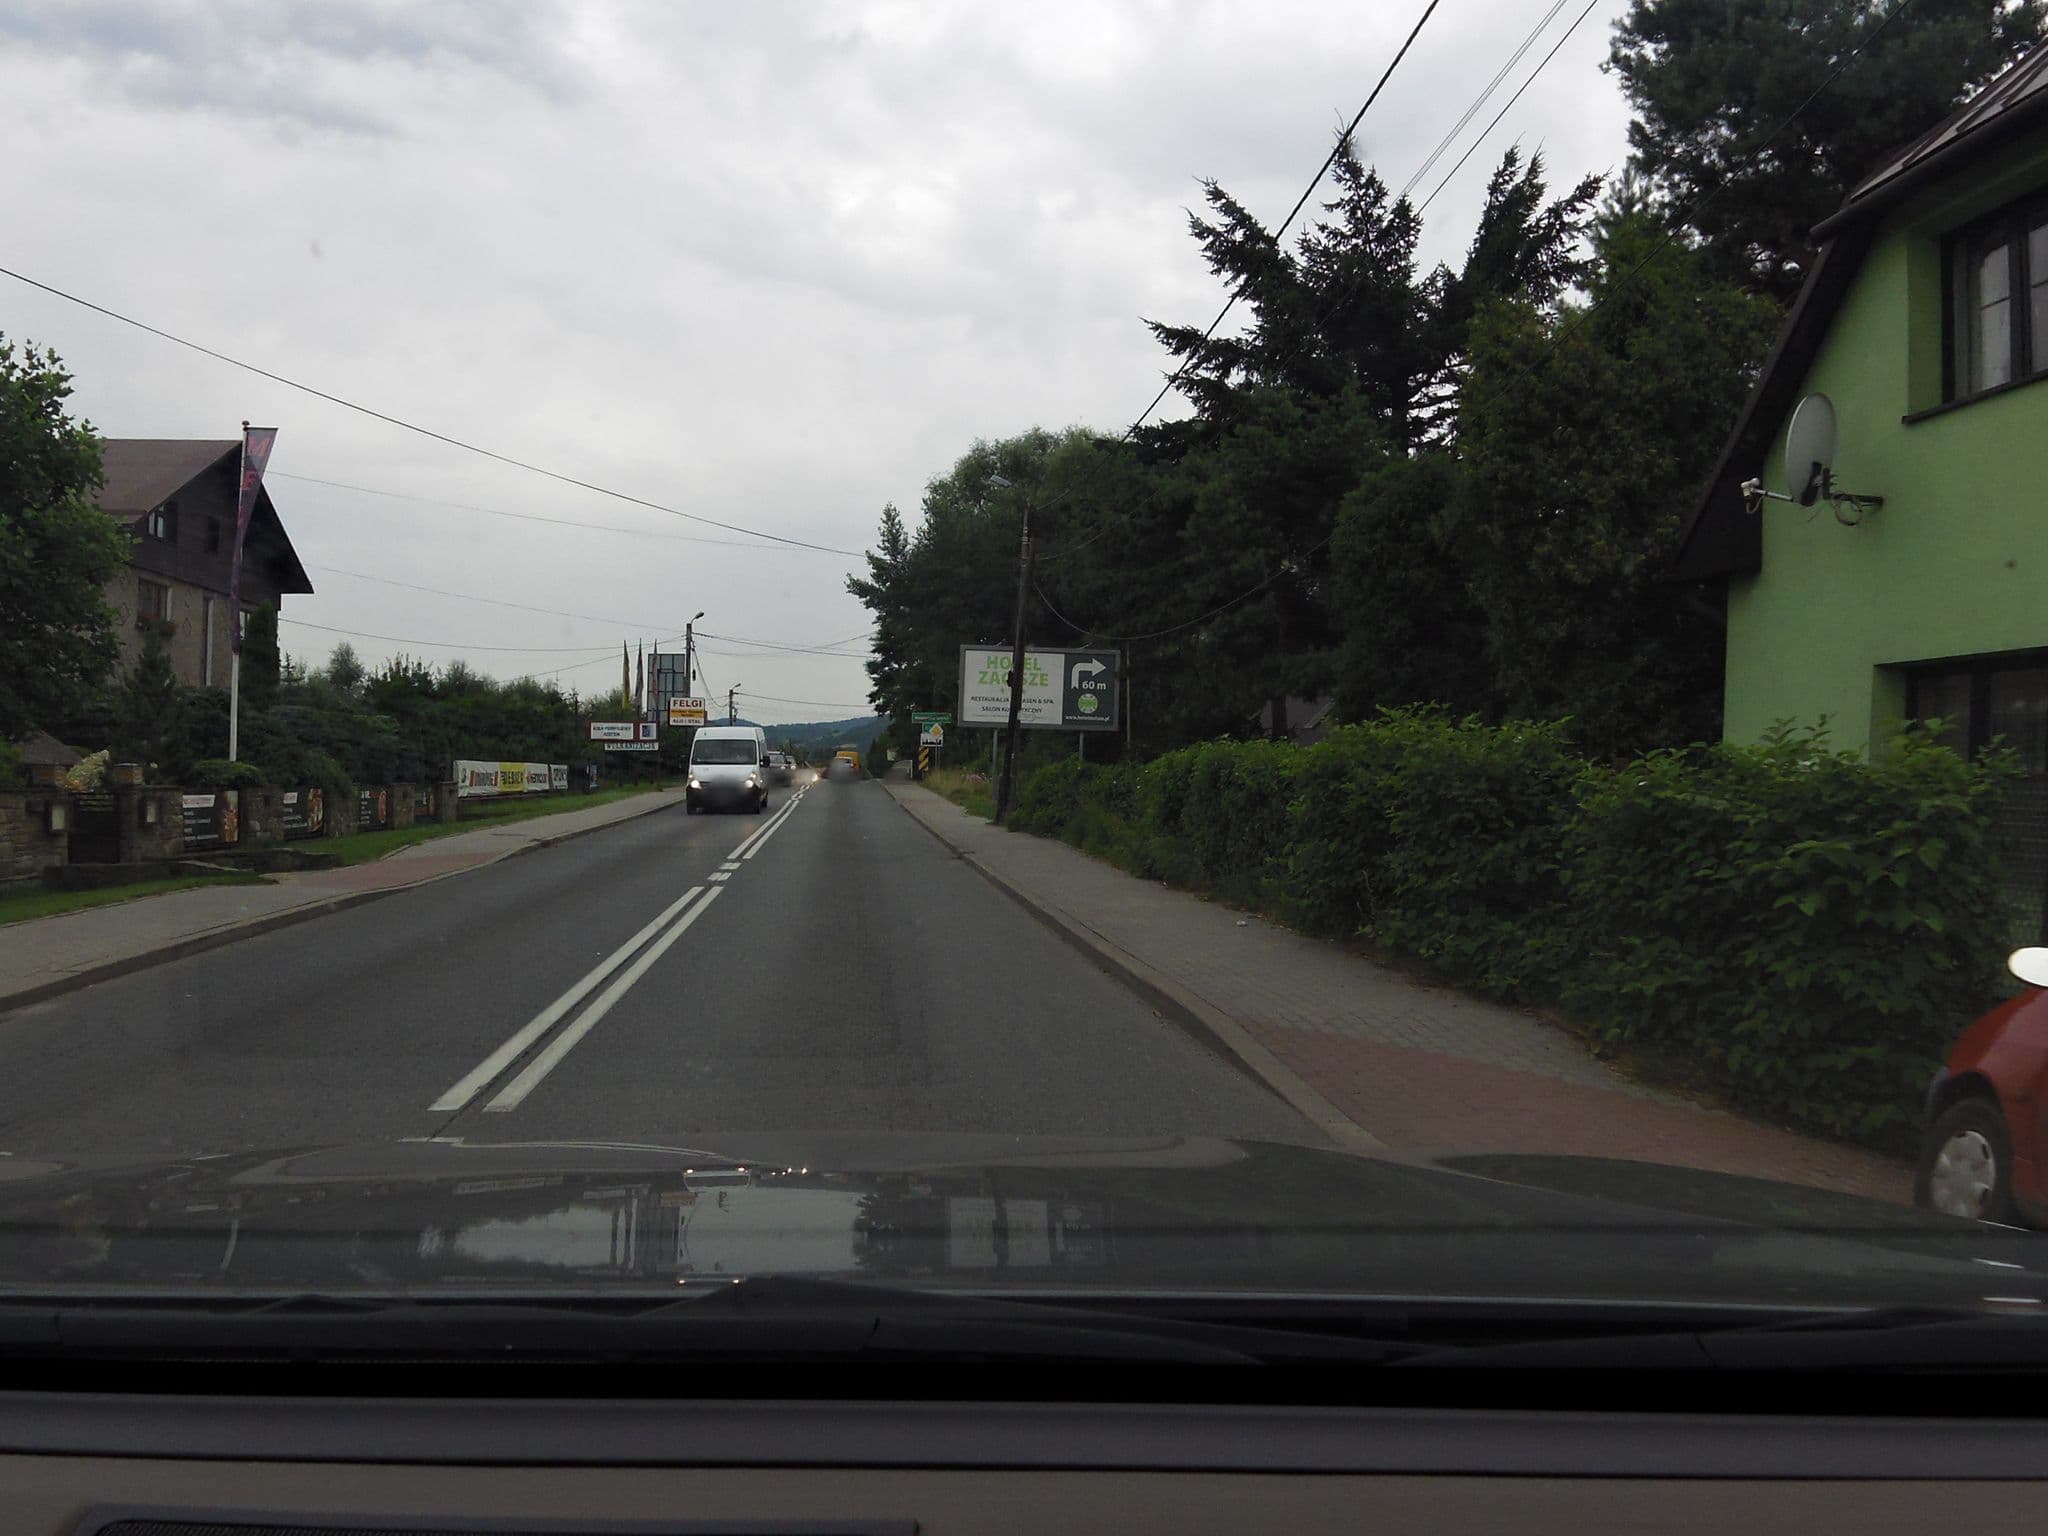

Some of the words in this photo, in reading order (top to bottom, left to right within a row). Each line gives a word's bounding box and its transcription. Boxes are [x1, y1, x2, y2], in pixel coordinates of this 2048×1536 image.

[986, 655, 1041, 671] HOEL
[978, 671, 1049, 687] ZACSZE
[1082, 680, 1095, 690] 60
[1096, 682, 1106, 690] m
[673, 699, 702, 708] FELGI
